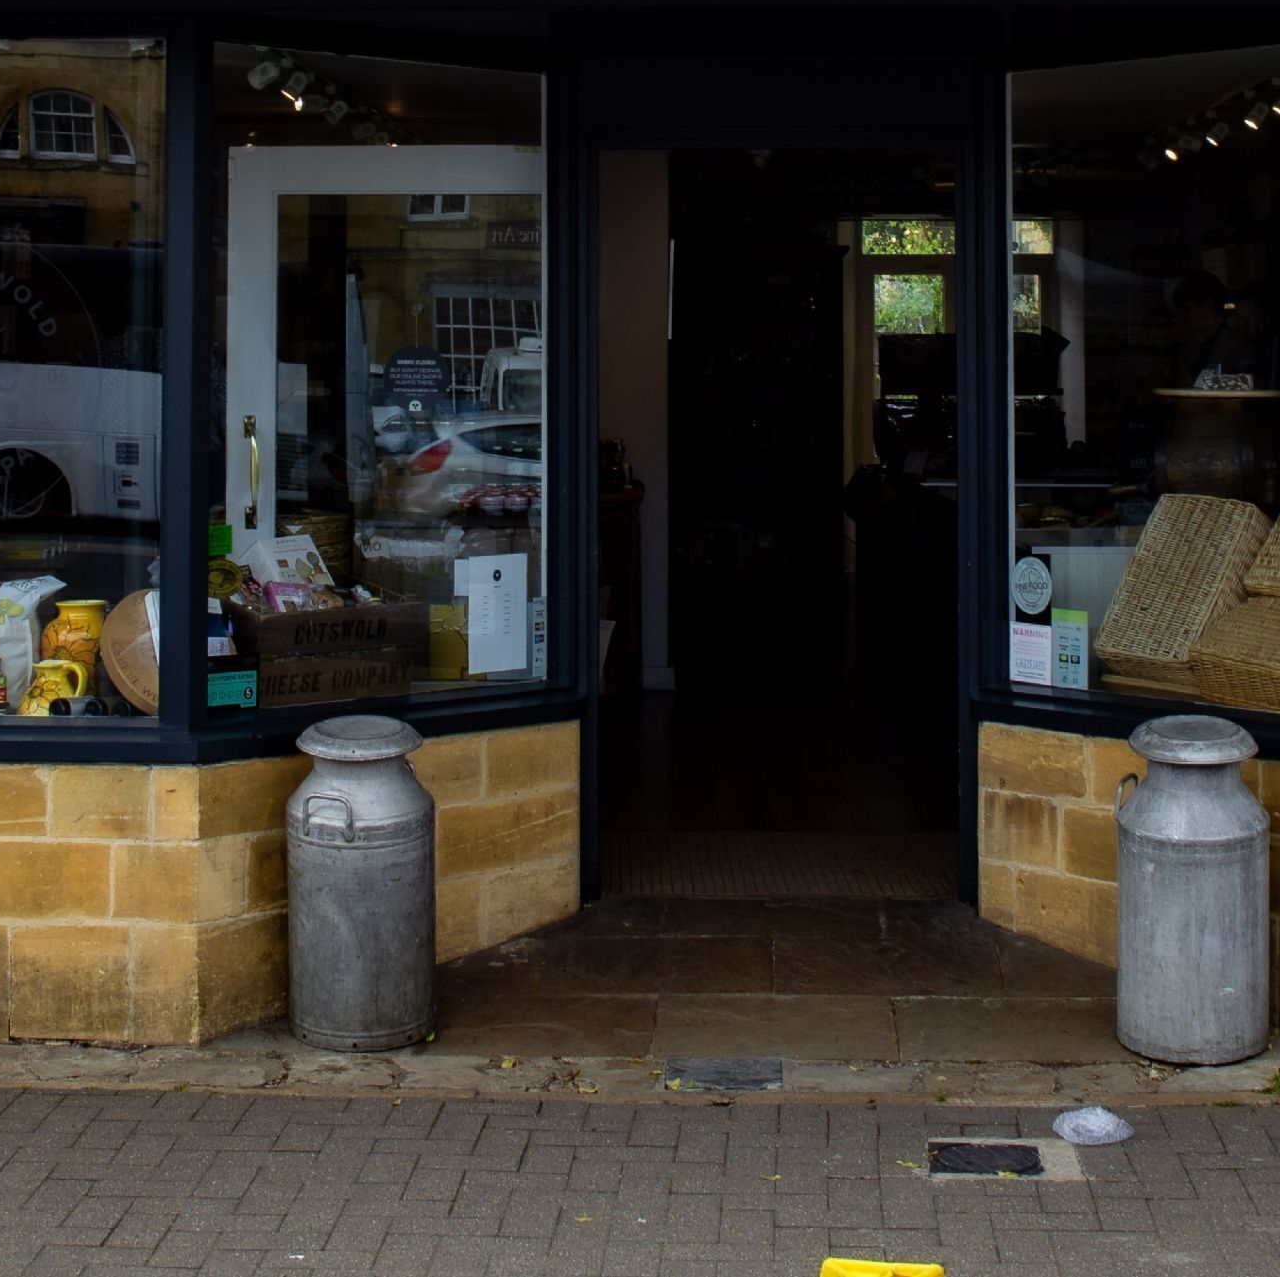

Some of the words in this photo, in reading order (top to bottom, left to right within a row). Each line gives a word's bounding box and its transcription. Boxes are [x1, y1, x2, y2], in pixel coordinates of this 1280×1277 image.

[295, 617, 387, 645] COTSWOLD
[1012, 627, 1050, 639] WARNING
[332, 665, 411, 693] COMPANY
